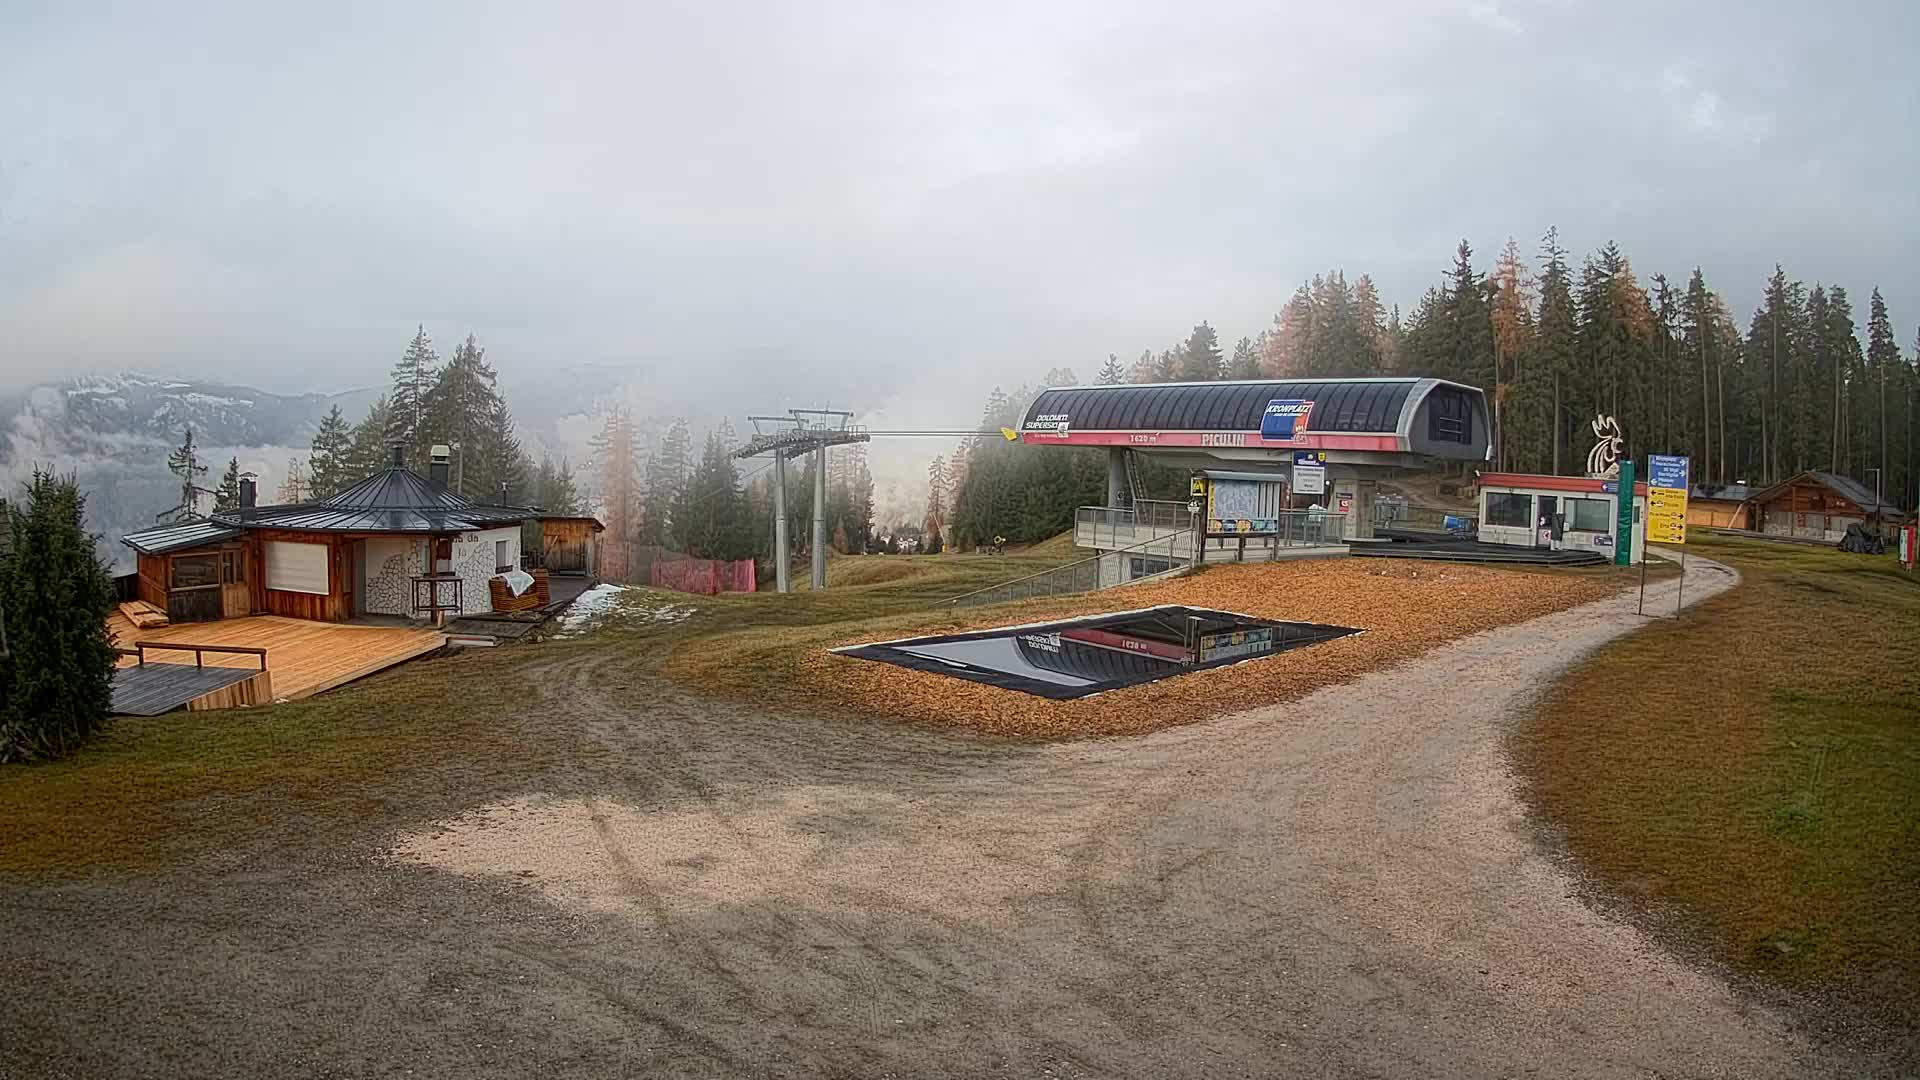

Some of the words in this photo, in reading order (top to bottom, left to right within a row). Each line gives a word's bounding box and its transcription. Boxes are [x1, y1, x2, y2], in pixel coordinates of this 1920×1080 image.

[1266, 404, 1310, 413] KRONPLATZ
[1036, 414, 1069, 422] DOLOMITI
[1025, 421, 1059, 429] SUPERSKI
[1201, 433, 1245, 447] PICULIN
